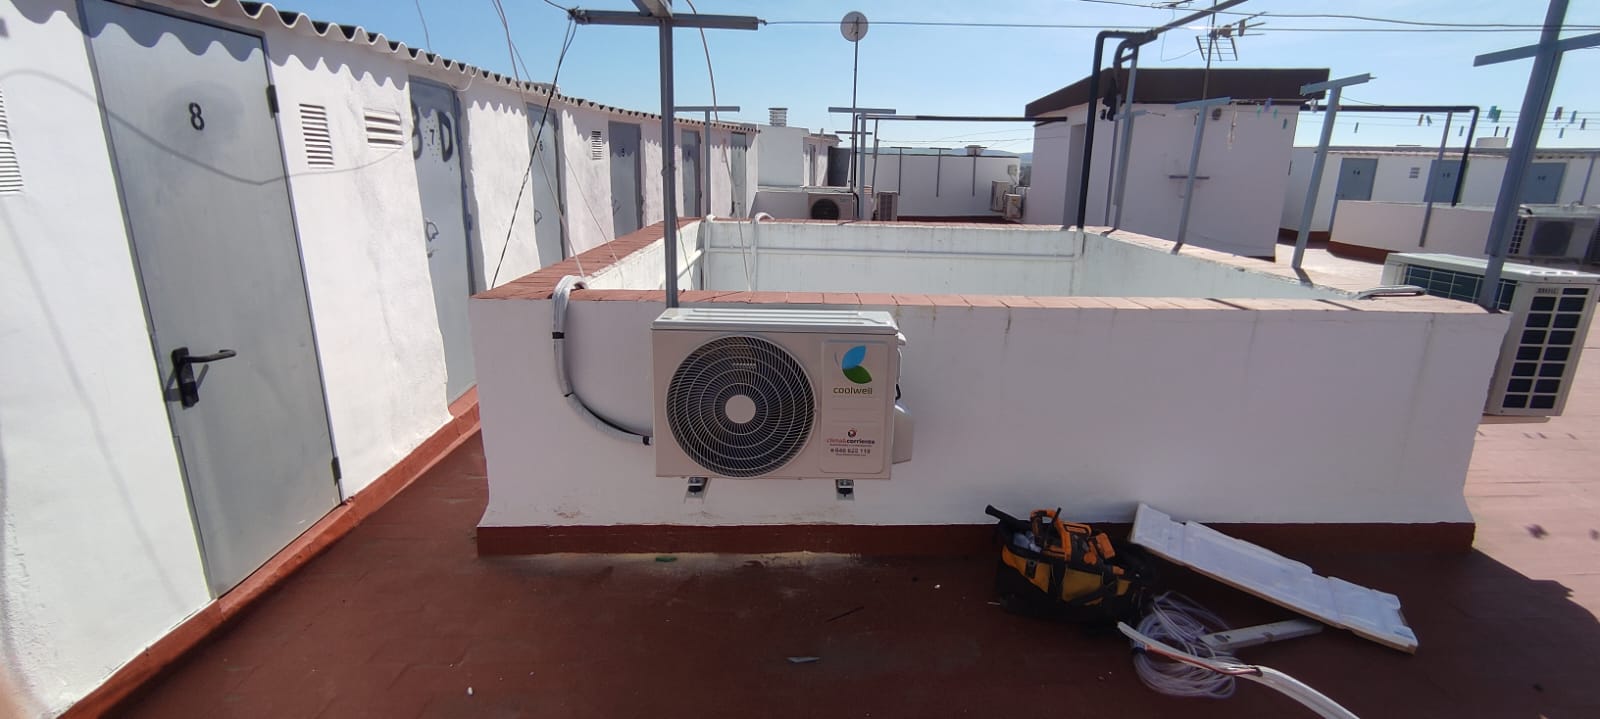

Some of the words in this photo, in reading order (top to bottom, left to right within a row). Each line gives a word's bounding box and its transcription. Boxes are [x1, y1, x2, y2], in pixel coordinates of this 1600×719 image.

[188, 102, 205, 131] 8
[429, 128, 435, 145] 7
[833, 386, 873, 395] coolwell
